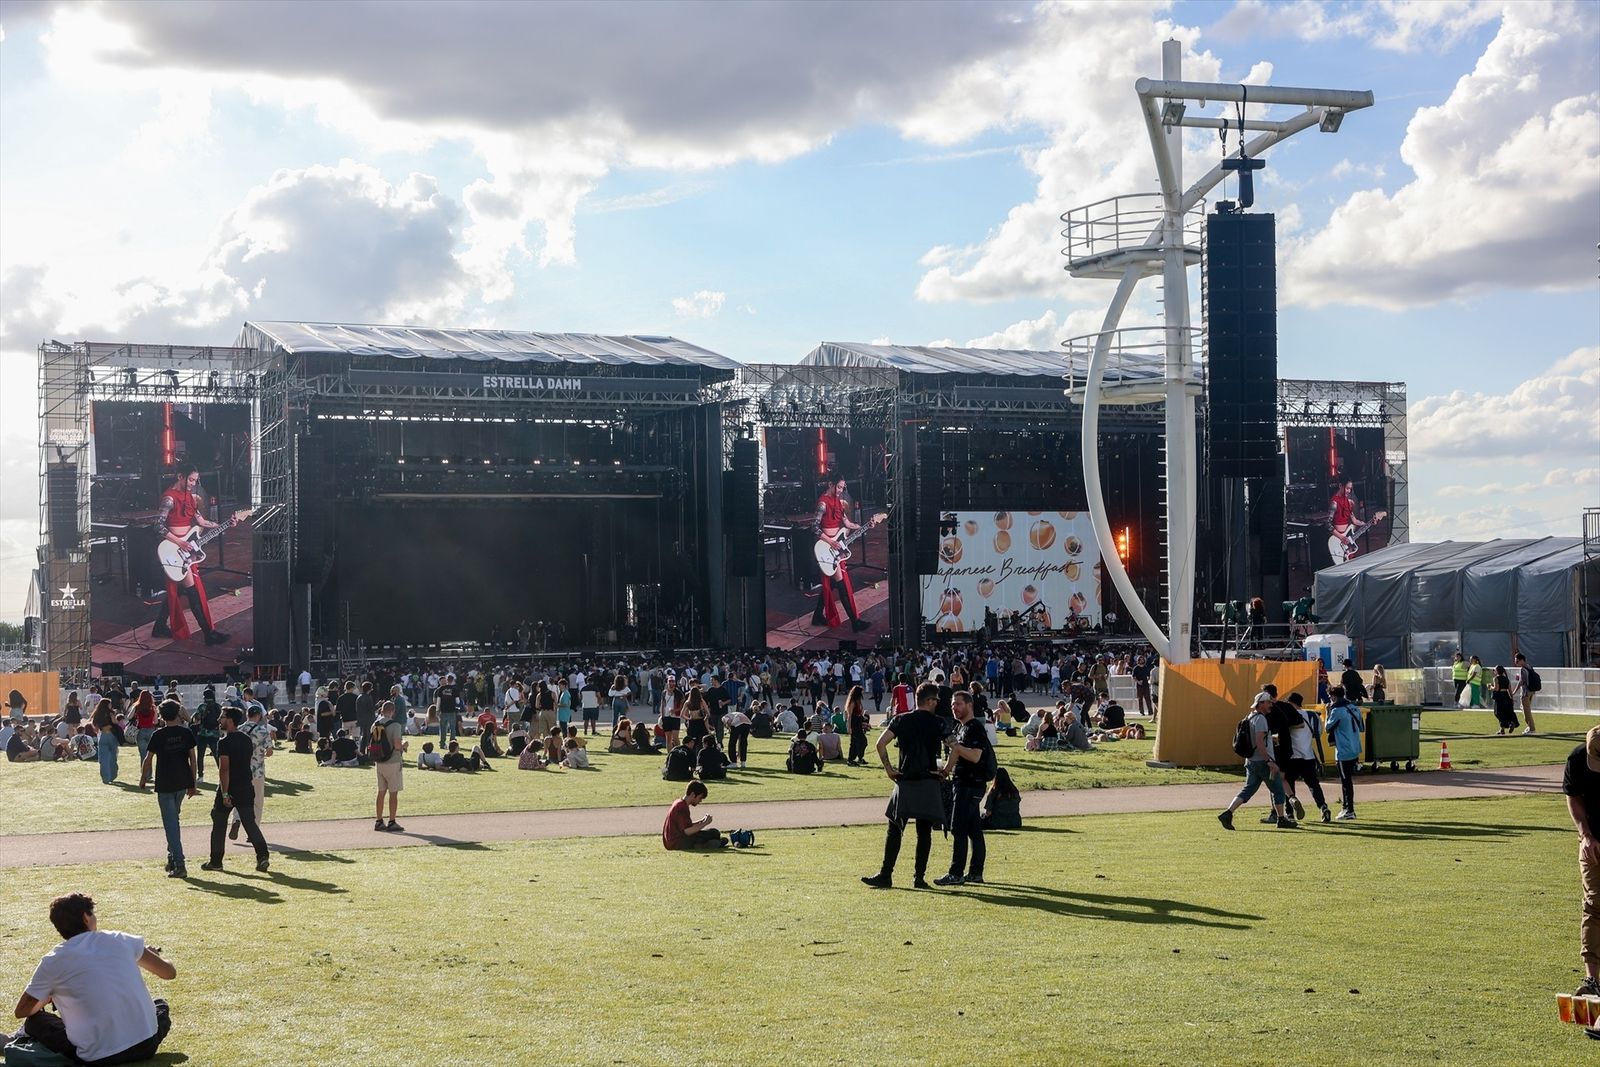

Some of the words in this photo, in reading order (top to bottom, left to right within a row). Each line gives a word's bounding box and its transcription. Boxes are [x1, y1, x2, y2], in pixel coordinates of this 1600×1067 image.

[483, 376, 544, 390] ESTRELLA
[547, 378, 581, 390] DAMM
[995, 558, 1084, 585] Breakfast
